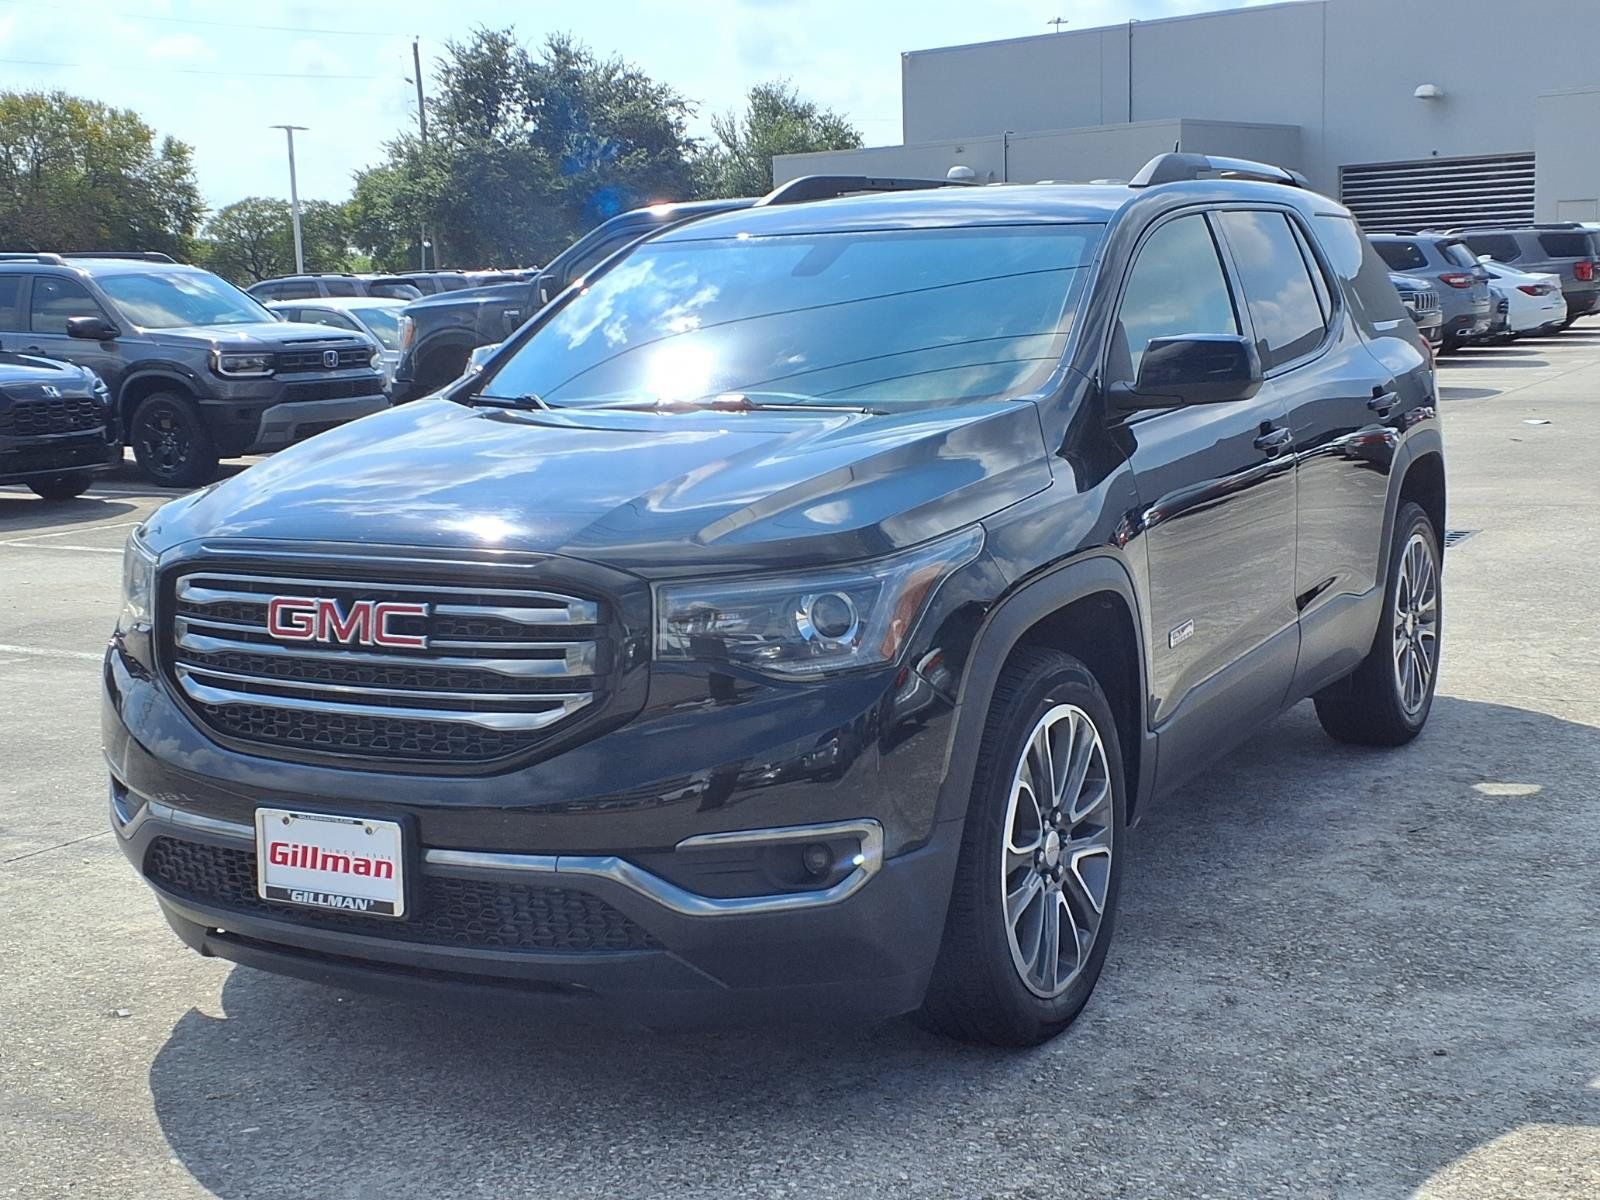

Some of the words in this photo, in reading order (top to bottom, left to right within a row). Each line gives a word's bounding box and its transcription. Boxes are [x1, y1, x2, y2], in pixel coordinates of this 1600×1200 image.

[268, 596, 428, 650] GMC
[270, 841, 393, 879] Gillman
[291, 890, 368, 911] GILLMAN
